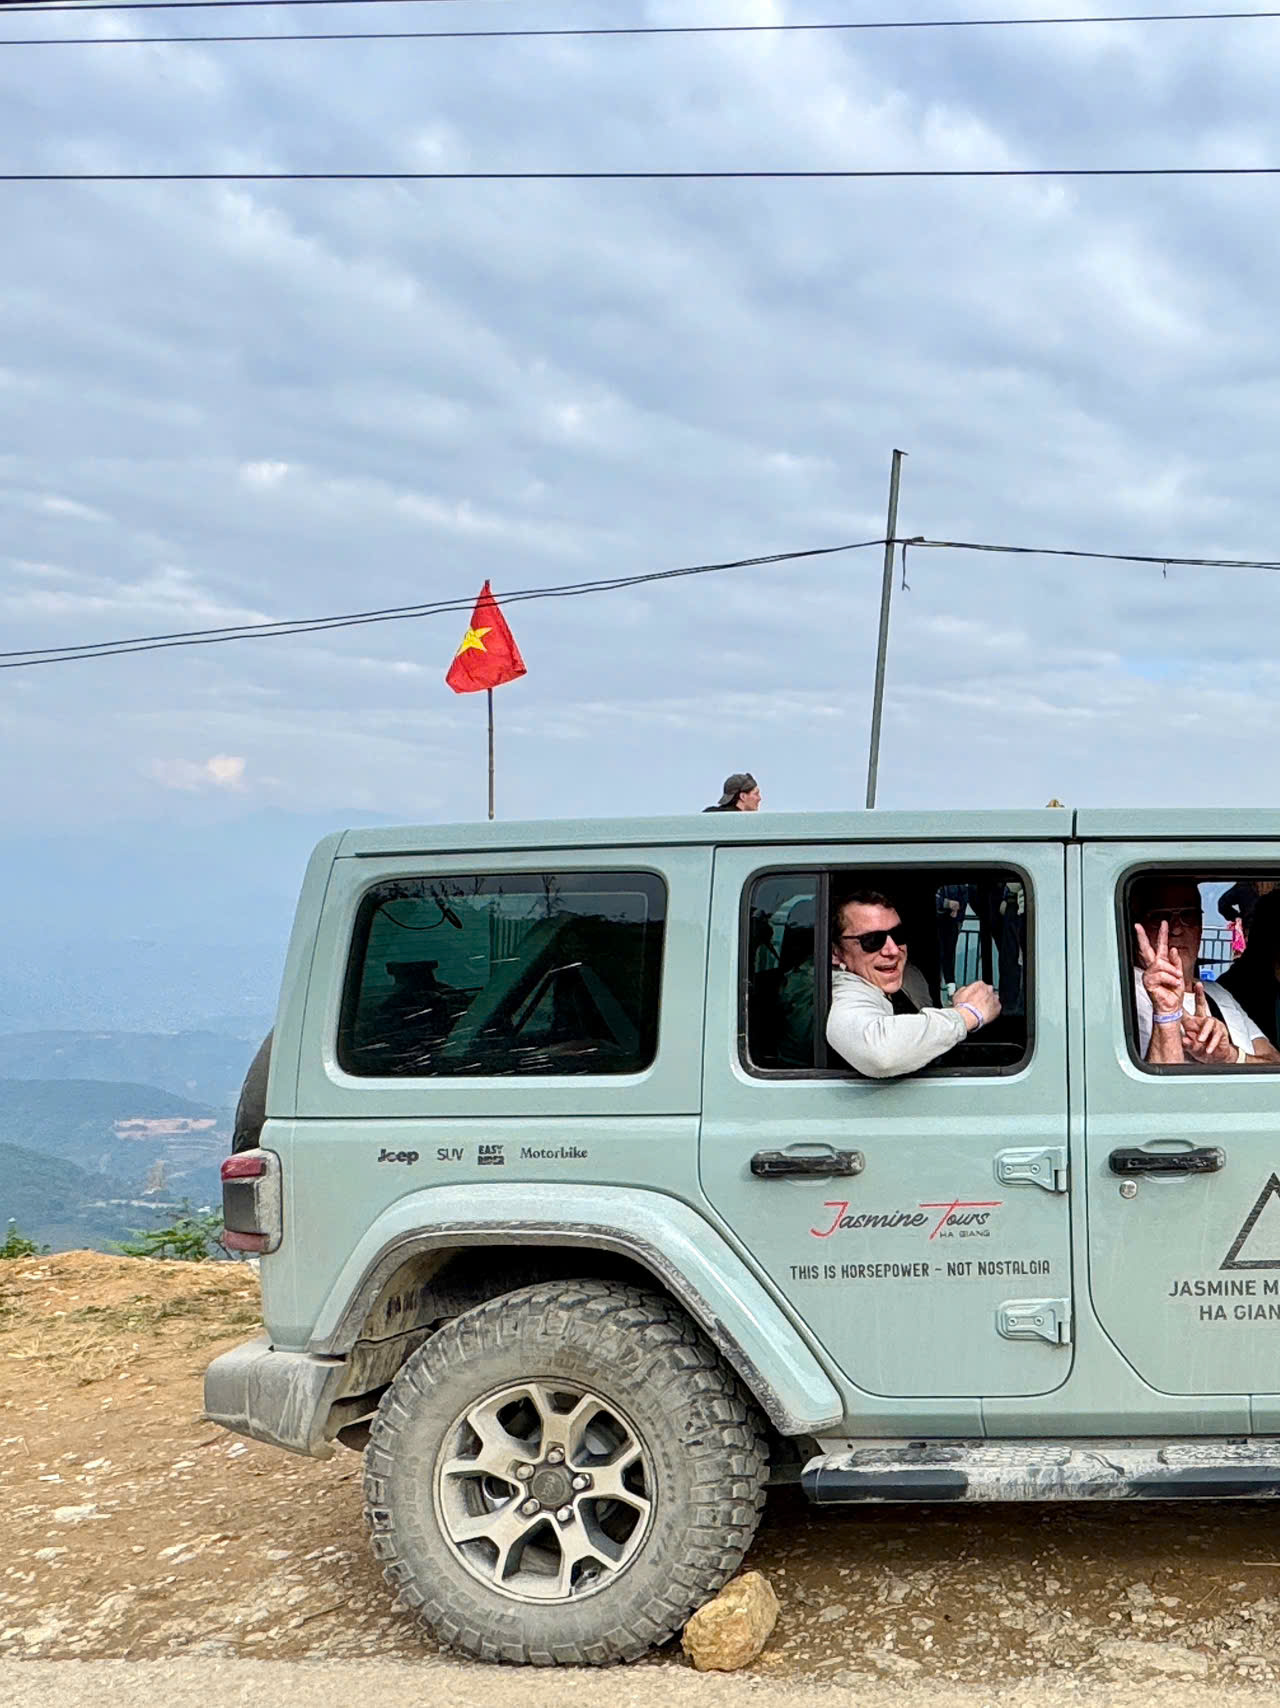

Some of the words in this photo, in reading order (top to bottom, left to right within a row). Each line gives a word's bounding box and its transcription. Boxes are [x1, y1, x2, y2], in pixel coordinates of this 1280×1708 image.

[378, 1148, 419, 1165] Jeep
[437, 1148, 464, 1161] SUV
[478, 1145, 504, 1155] EASY
[520, 1146, 588, 1159] Motorbike
[810, 1201, 928, 1237] Jasmine
[919, 1199, 1003, 1240] Tours
[790, 1265, 819, 1280] THIS
[824, 1264, 836, 1279] IS
[842, 1262, 929, 1279] HORSEPOWER
[947, 1261, 973, 1276] NOT
[978, 1260, 1050, 1276] NOSTALGIA
[1169, 1279, 1257, 1297] JASMINE
[1199, 1304, 1227, 1321] HA
